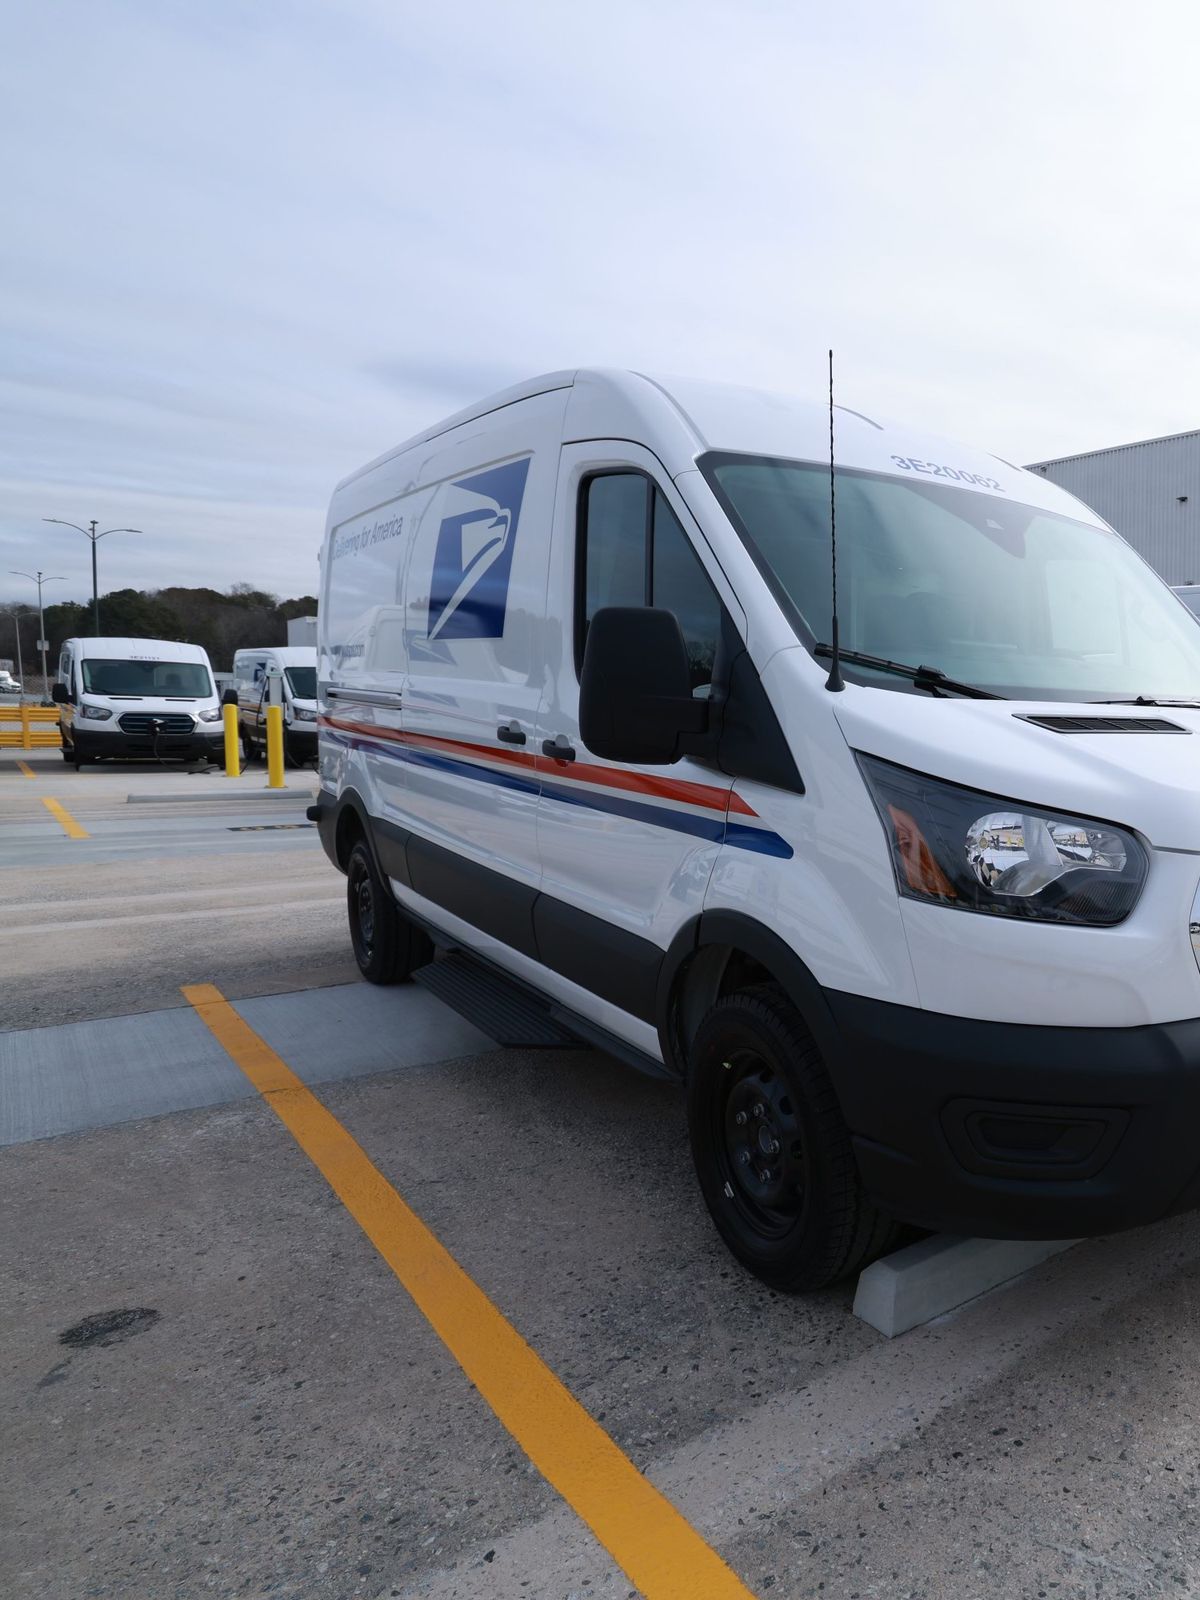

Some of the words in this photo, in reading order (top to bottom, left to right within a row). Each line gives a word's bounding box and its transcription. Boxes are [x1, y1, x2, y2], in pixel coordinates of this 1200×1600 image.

[891, 455, 1006, 492] 3E20062
[360, 526, 371, 549] for
[370, 514, 404, 546] America
